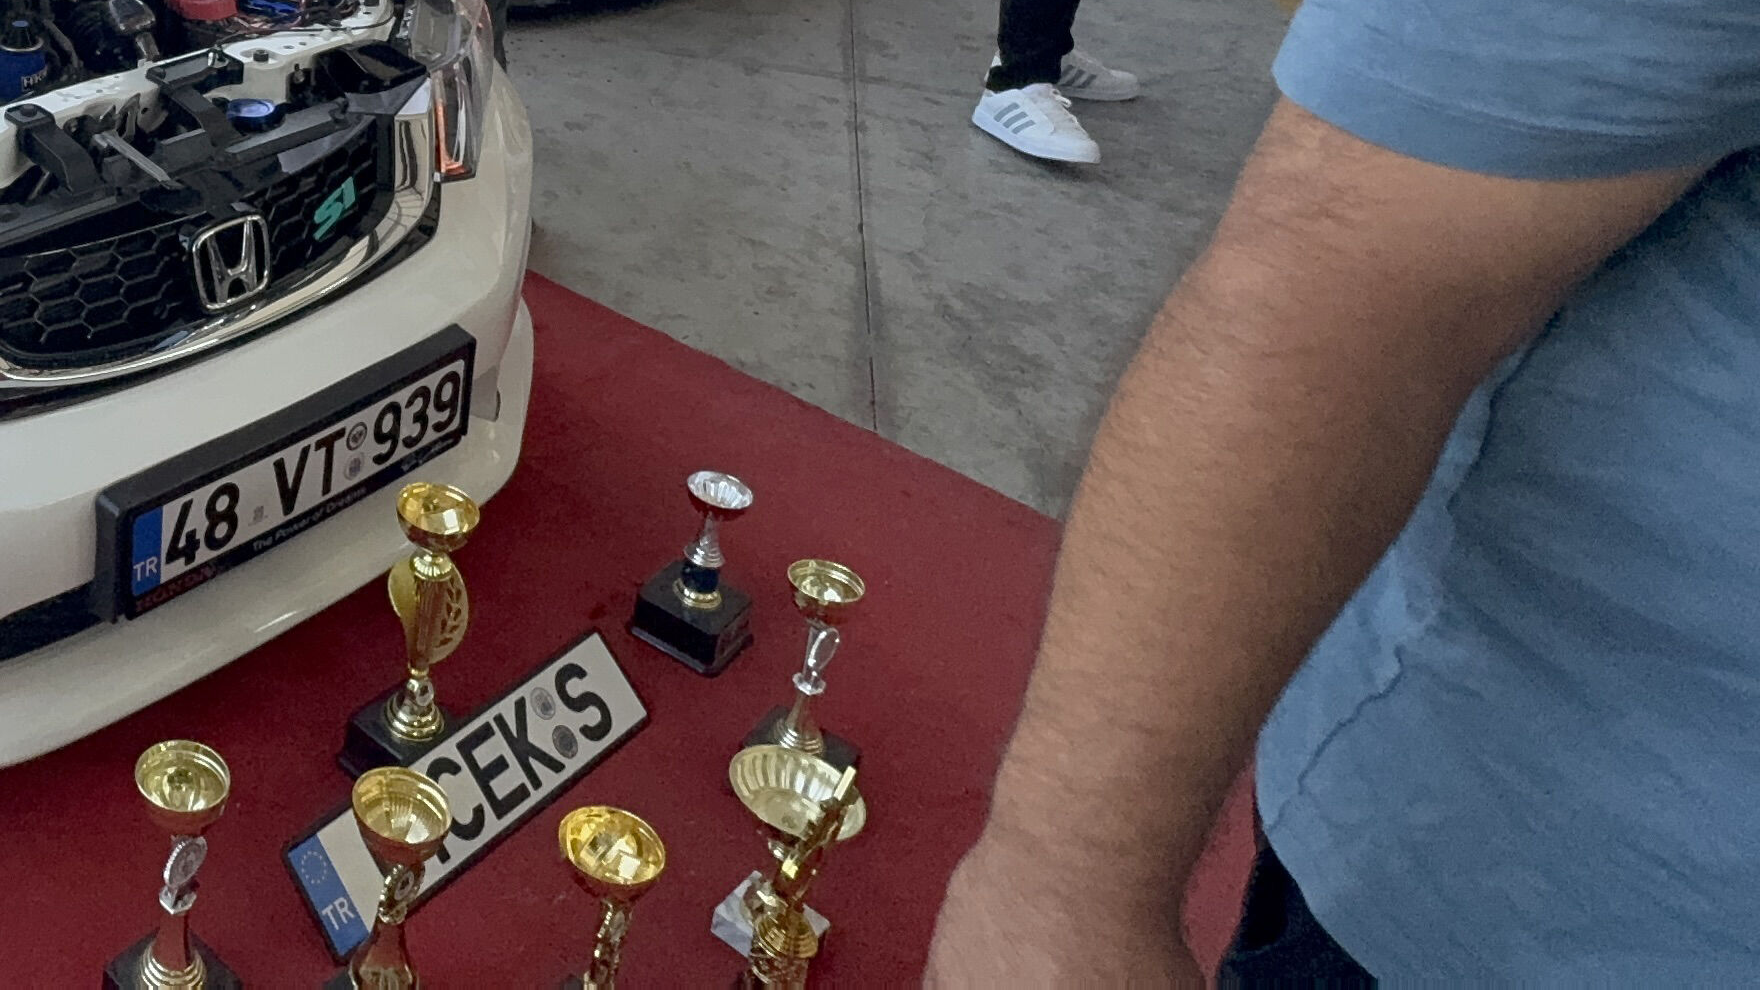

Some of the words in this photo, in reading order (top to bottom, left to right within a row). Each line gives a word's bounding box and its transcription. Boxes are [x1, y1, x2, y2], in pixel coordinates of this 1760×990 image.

[133, 556, 158, 582] TR
[165, 481, 240, 566] 48
[273, 427, 346, 517] VT
[372, 370, 461, 466] 939
[321, 896, 355, 931] TR
[426, 696, 567, 864] CEK
[554, 662, 613, 742] S
